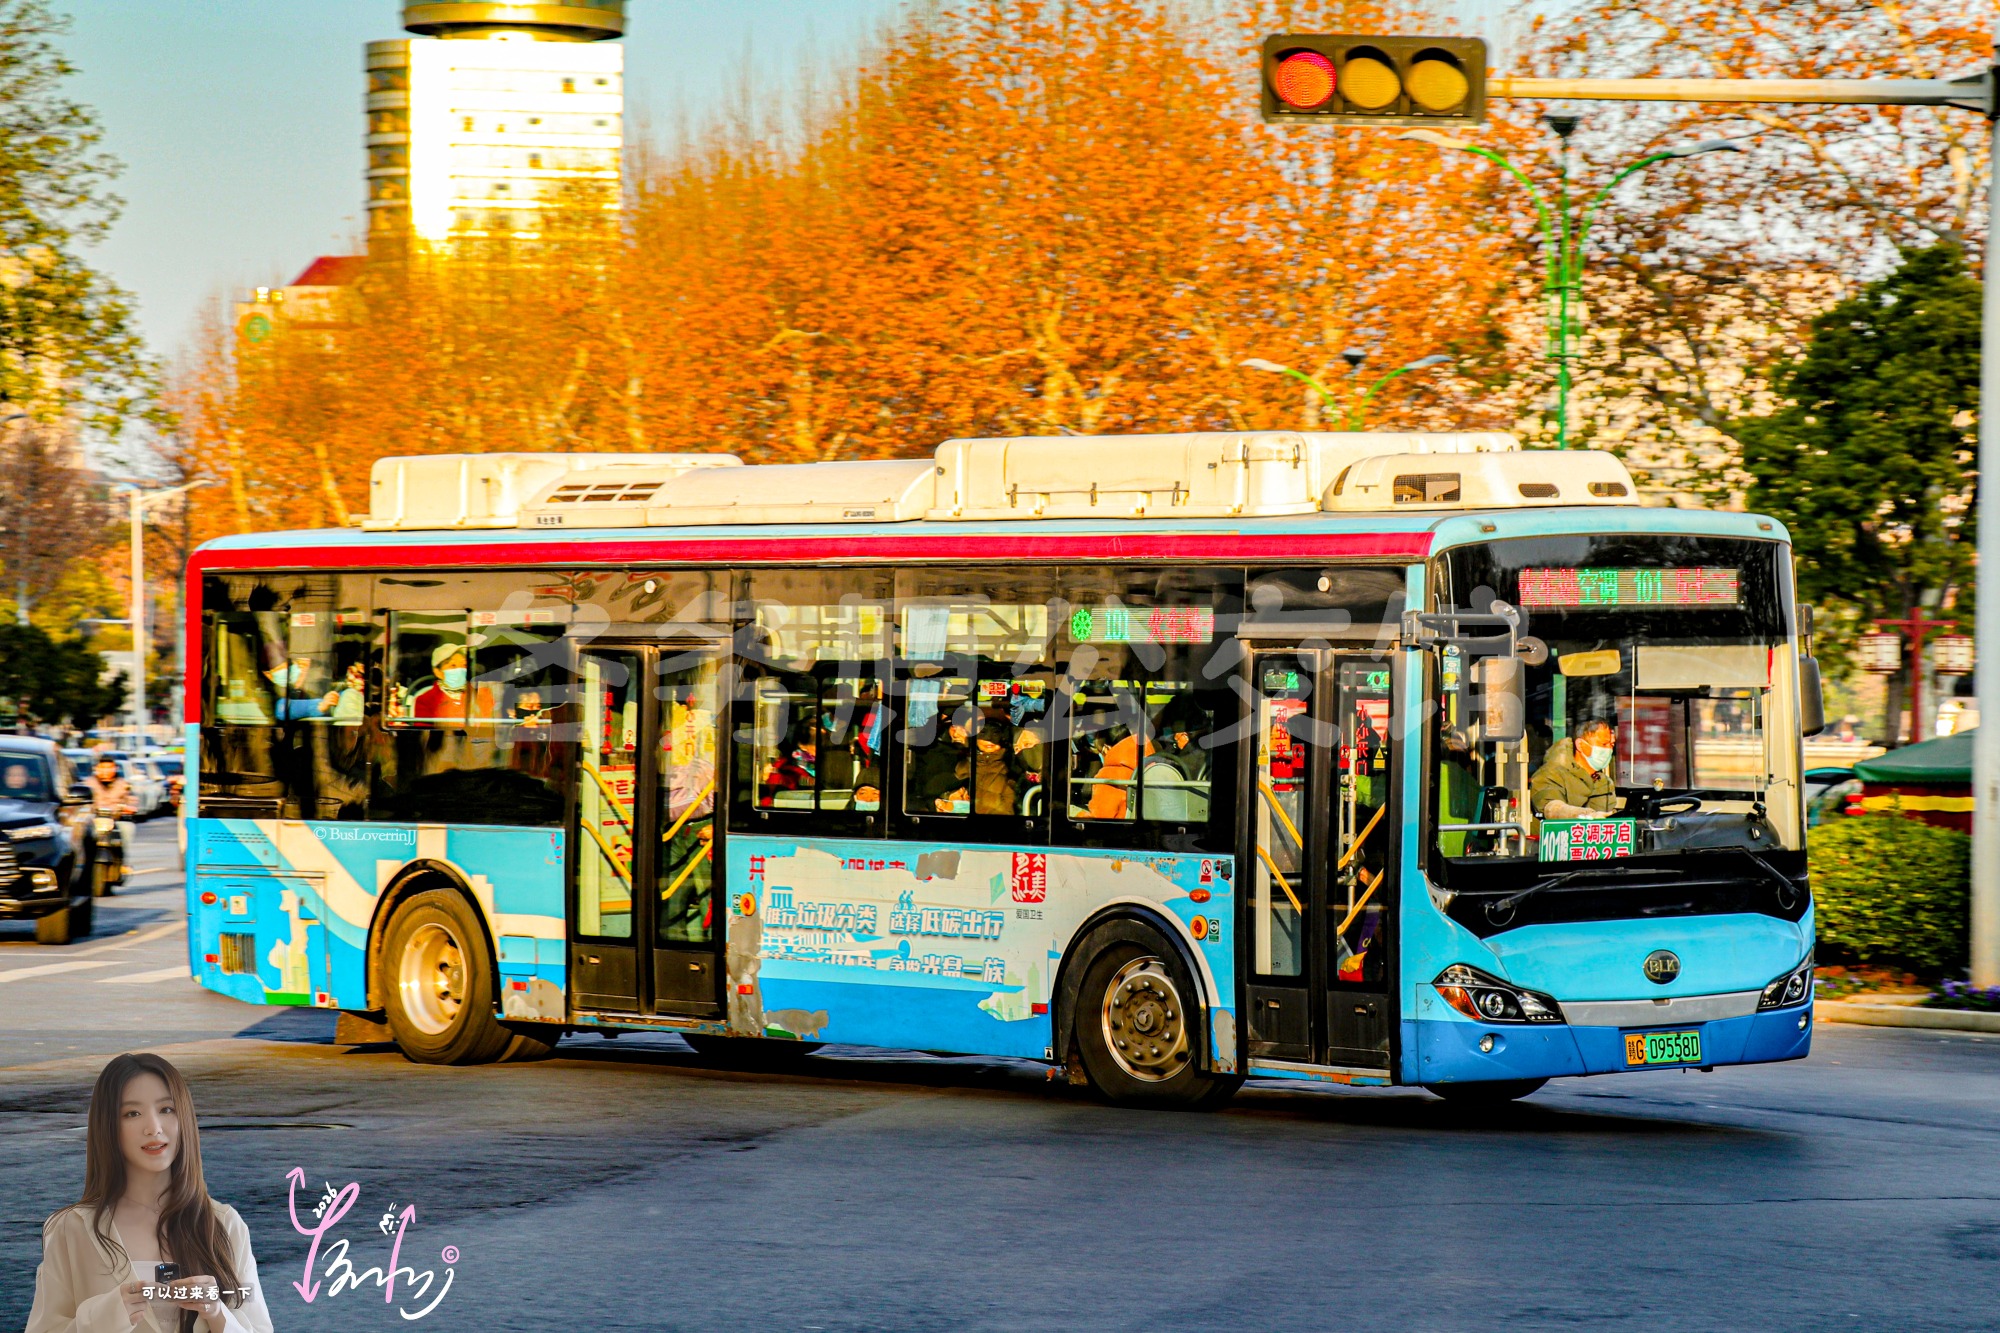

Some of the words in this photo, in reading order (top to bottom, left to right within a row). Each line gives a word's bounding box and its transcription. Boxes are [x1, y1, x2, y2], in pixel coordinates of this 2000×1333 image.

[1634, 571, 1662, 602] 101
[1105, 609, 1130, 640] 101
[1570, 823, 1632, 845] 空调开启
[764, 902, 878, 933] 推行垃圾分类
[890, 908, 1005, 940] 选择低碳出行
[1016, 909, 1044, 921] 爱国卫生
[1649, 959, 1677, 973] BLK
